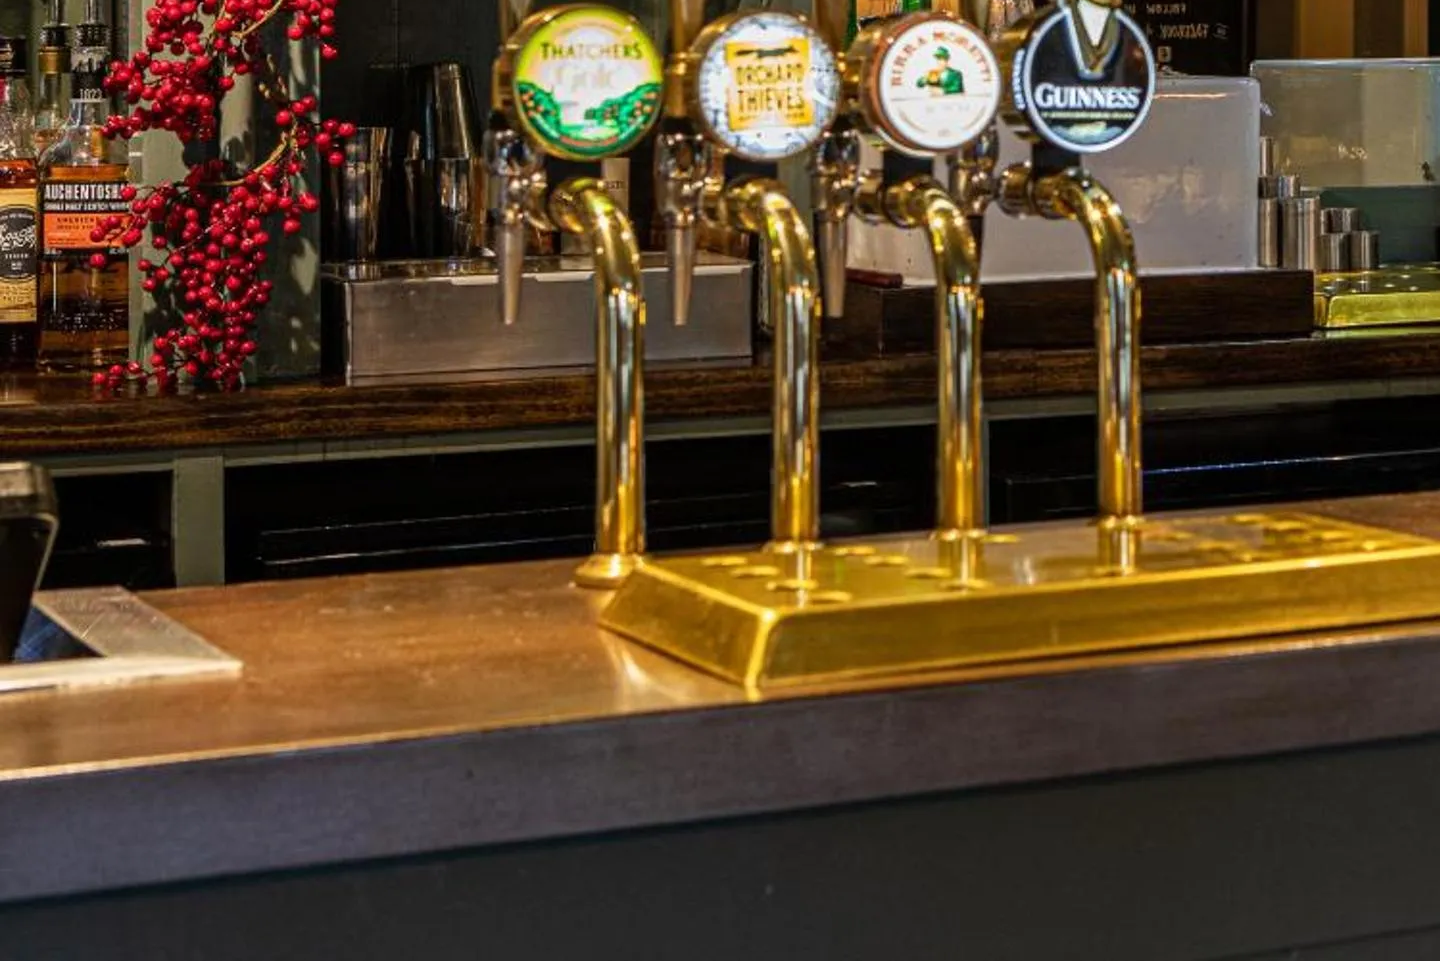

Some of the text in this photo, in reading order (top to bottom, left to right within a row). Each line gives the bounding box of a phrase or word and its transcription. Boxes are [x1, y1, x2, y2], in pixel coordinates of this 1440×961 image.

[540, 42, 642, 60] THATCHERS
[891, 36, 928, 87] BIRRA
[737, 86, 805, 113] THIEVES
[1034, 82, 1142, 109] GUINNESS
[44, 183, 124, 200] AUCHENTOSH
